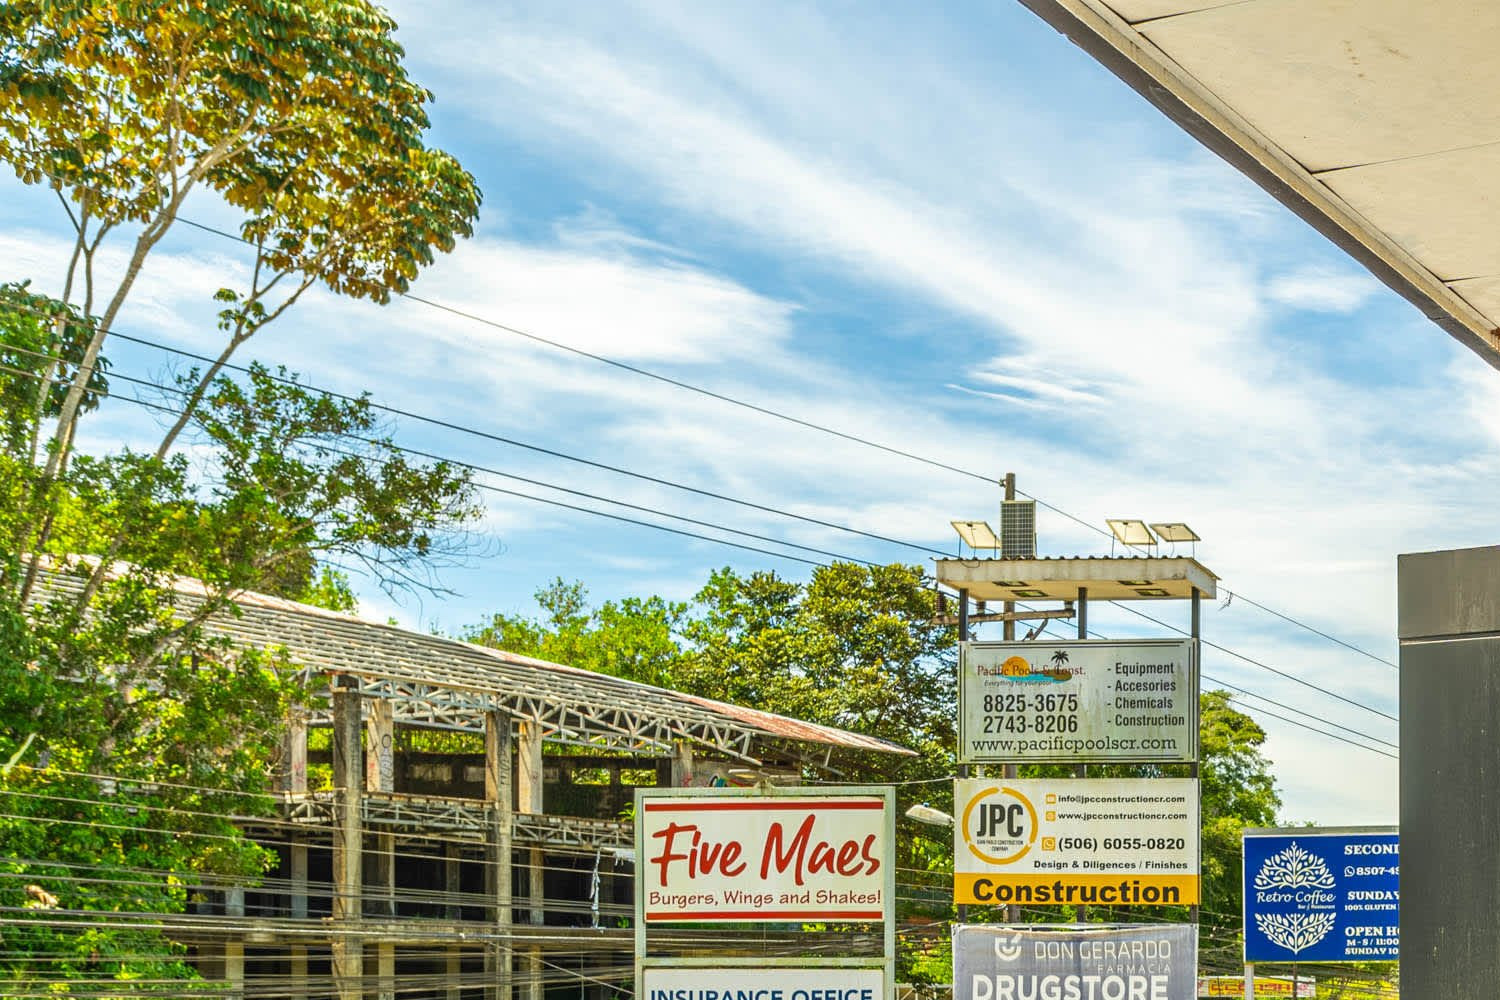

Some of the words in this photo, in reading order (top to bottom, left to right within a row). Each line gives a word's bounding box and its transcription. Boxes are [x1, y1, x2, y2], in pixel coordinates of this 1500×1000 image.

[1115, 662, 1174, 677] Equipment
[1115, 680, 1177, 692] Accesories
[983, 694, 1078, 713] 8825-3675
[1115, 696, 1174, 709] Chemicals
[983, 714, 1078, 734] 2743-8206
[1115, 714, 1185, 727] Construction
[972, 736, 1177, 754] www.pacificpoolscr.com
[976, 804, 1024, 838] JPC
[1058, 813, 1187, 821] www.jpcconstructioncr.com
[650, 822, 748, 887] Five
[760, 813, 881, 886] Maes
[1058, 838, 1098, 852] (506)
[1103, 838, 1185, 850] 6055-0820
[1034, 861, 1069, 870] Design
[1071, 861, 1080, 869] &
[1083, 861, 1136, 870] Diligences
[1145, 861, 1188, 869] Finishes
[973, 879, 1180, 903] Construction
[1256, 891, 1294, 903] Retro
[1295, 889, 1337, 905] Coffee
[649, 891, 719, 909] Burgers,
[723, 890, 774, 908] Wings
[779, 891, 811, 905] and
[815, 889, 882, 905] Shakes!
[1344, 926, 1384, 937] OPEN
[1034, 941, 1074, 959] DON
[1079, 940, 1171, 960] GERARDO
[1344, 947, 1387, 955] SUNDAY
[1098, 964, 1171, 974] FARMACIA
